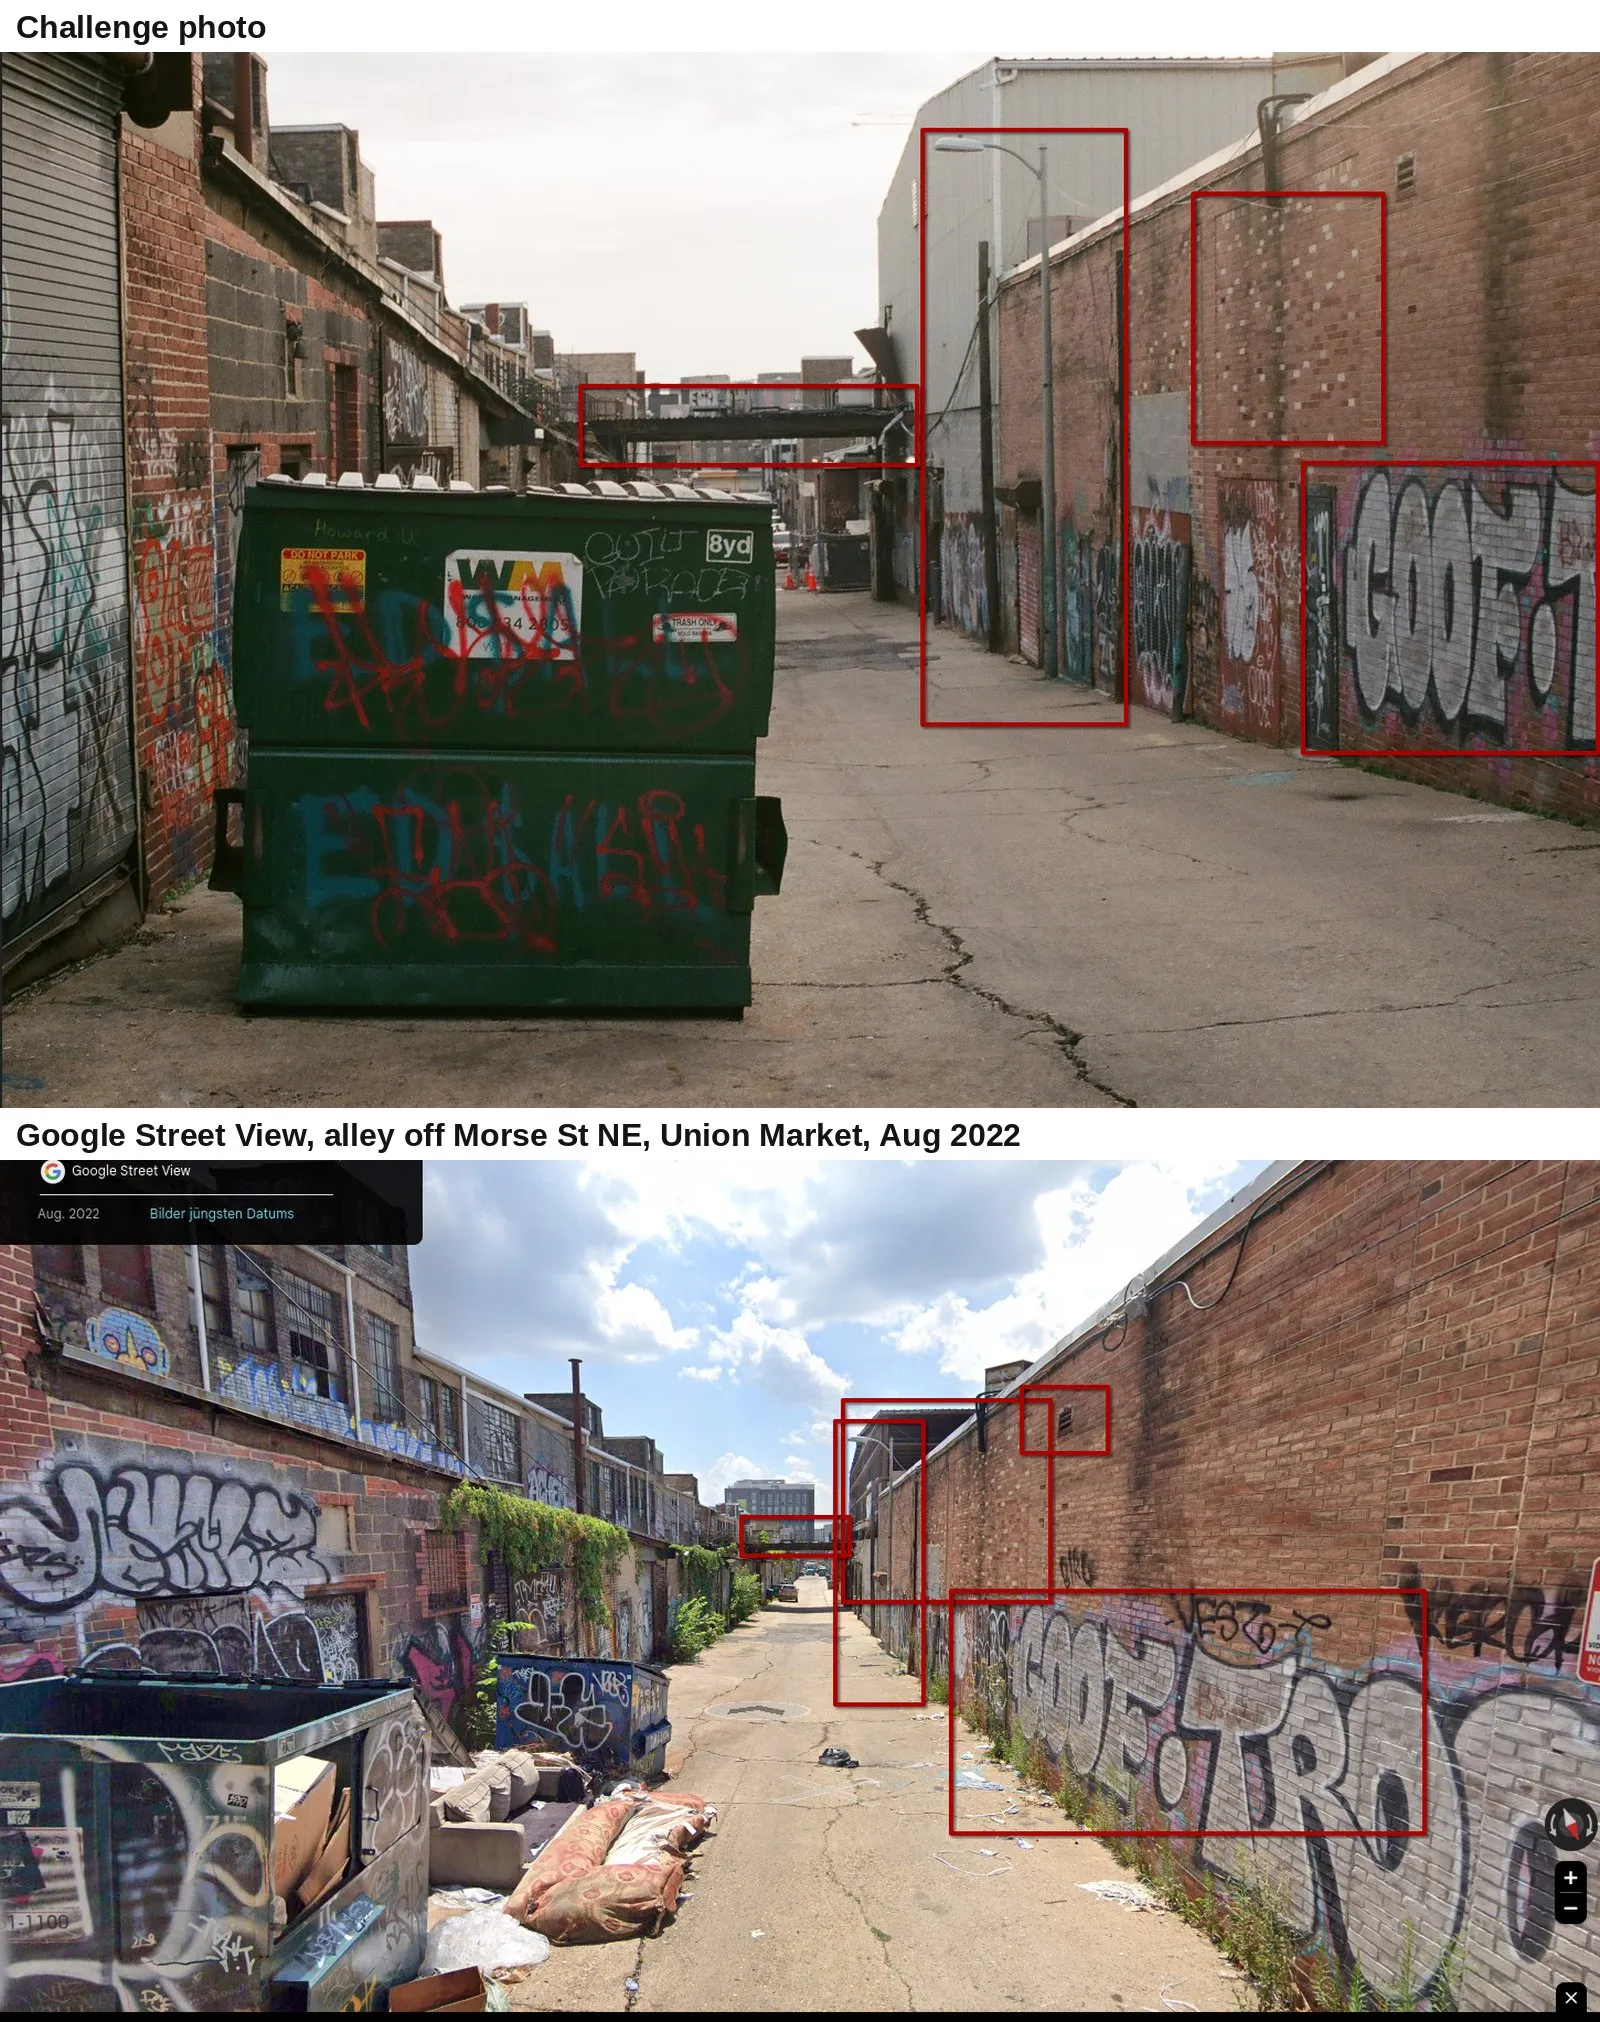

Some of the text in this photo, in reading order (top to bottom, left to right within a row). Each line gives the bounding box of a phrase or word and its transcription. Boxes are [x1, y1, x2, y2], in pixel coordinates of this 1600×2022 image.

[315, 518, 388, 543] Howard
[709, 534, 751, 558] 8yd
[290, 550, 358, 560] DO NOT PARK
[672, 618, 696, 626] TRASH
